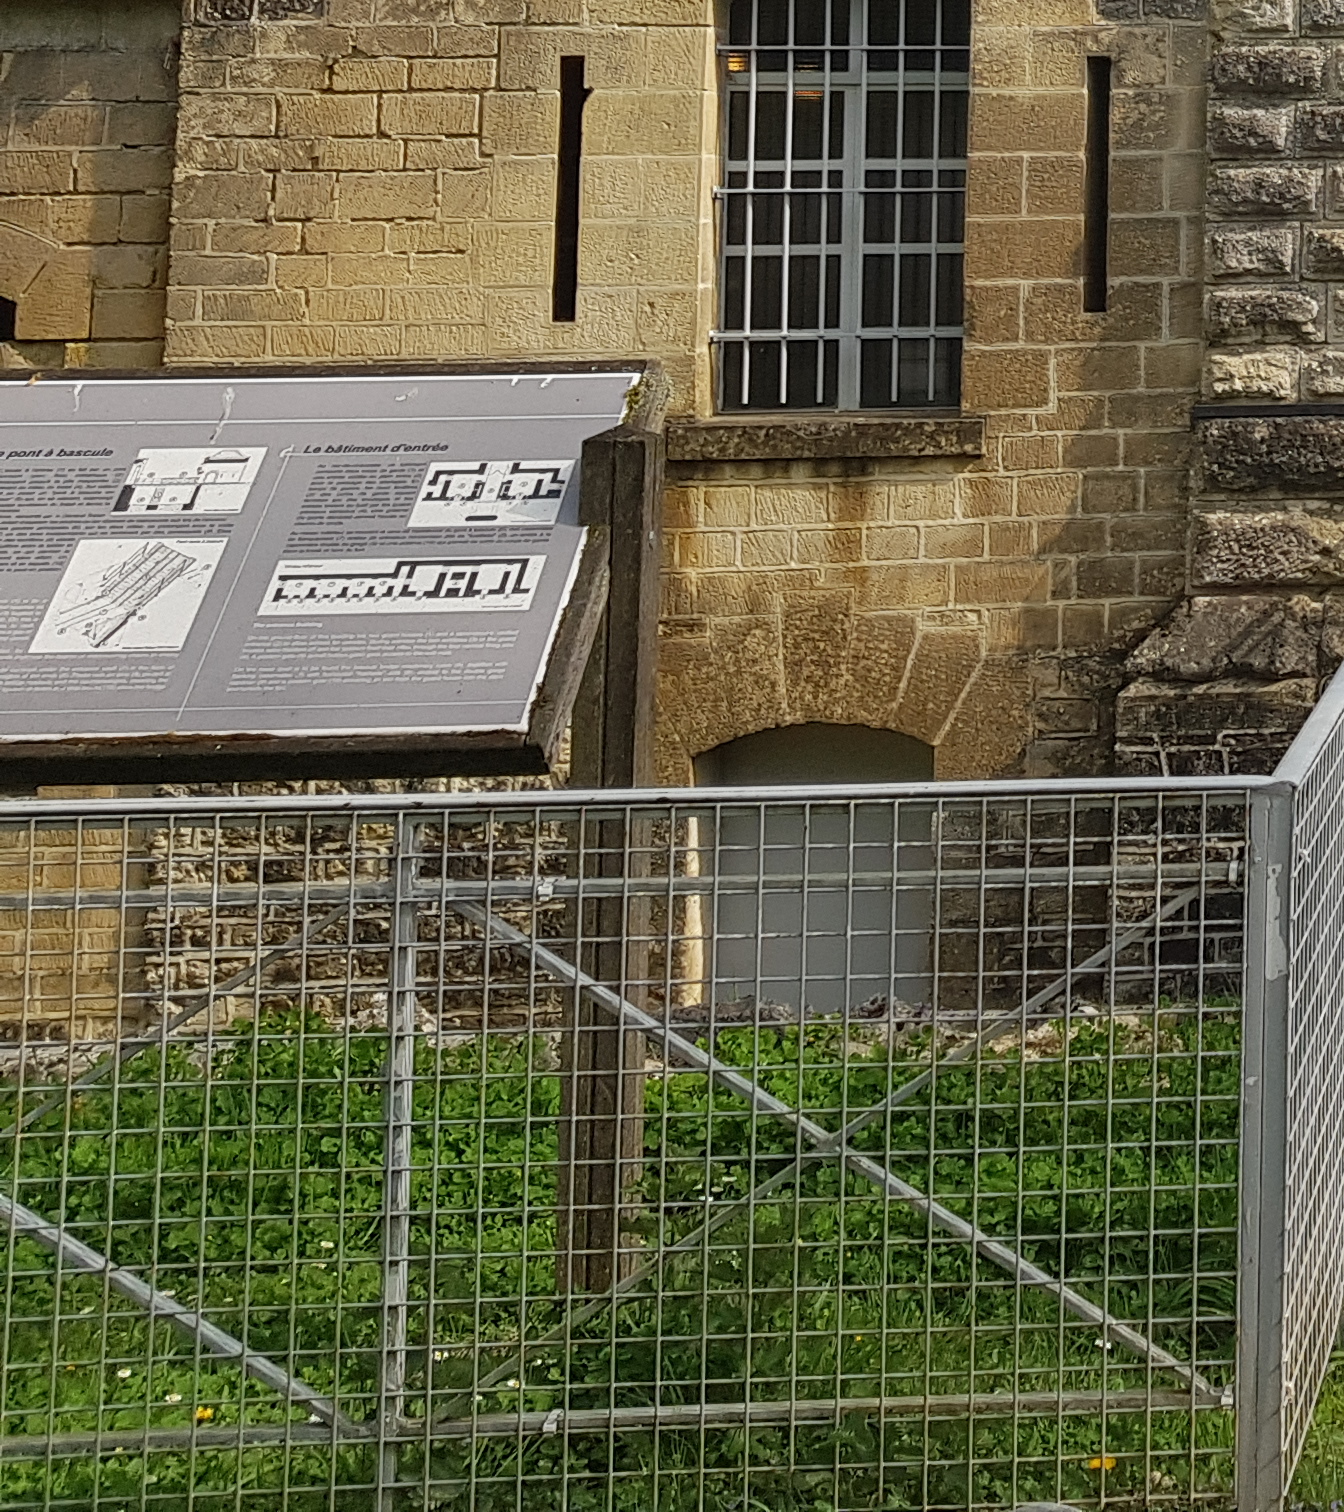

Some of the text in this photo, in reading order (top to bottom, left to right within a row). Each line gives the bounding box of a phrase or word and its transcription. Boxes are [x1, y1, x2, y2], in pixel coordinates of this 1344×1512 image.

[6, 449, 44, 459] pont
[44, 449, 53, 457] à
[56, 448, 113, 457] bascule
[304, 442, 449, 454] Le bâtiment d'entrée
